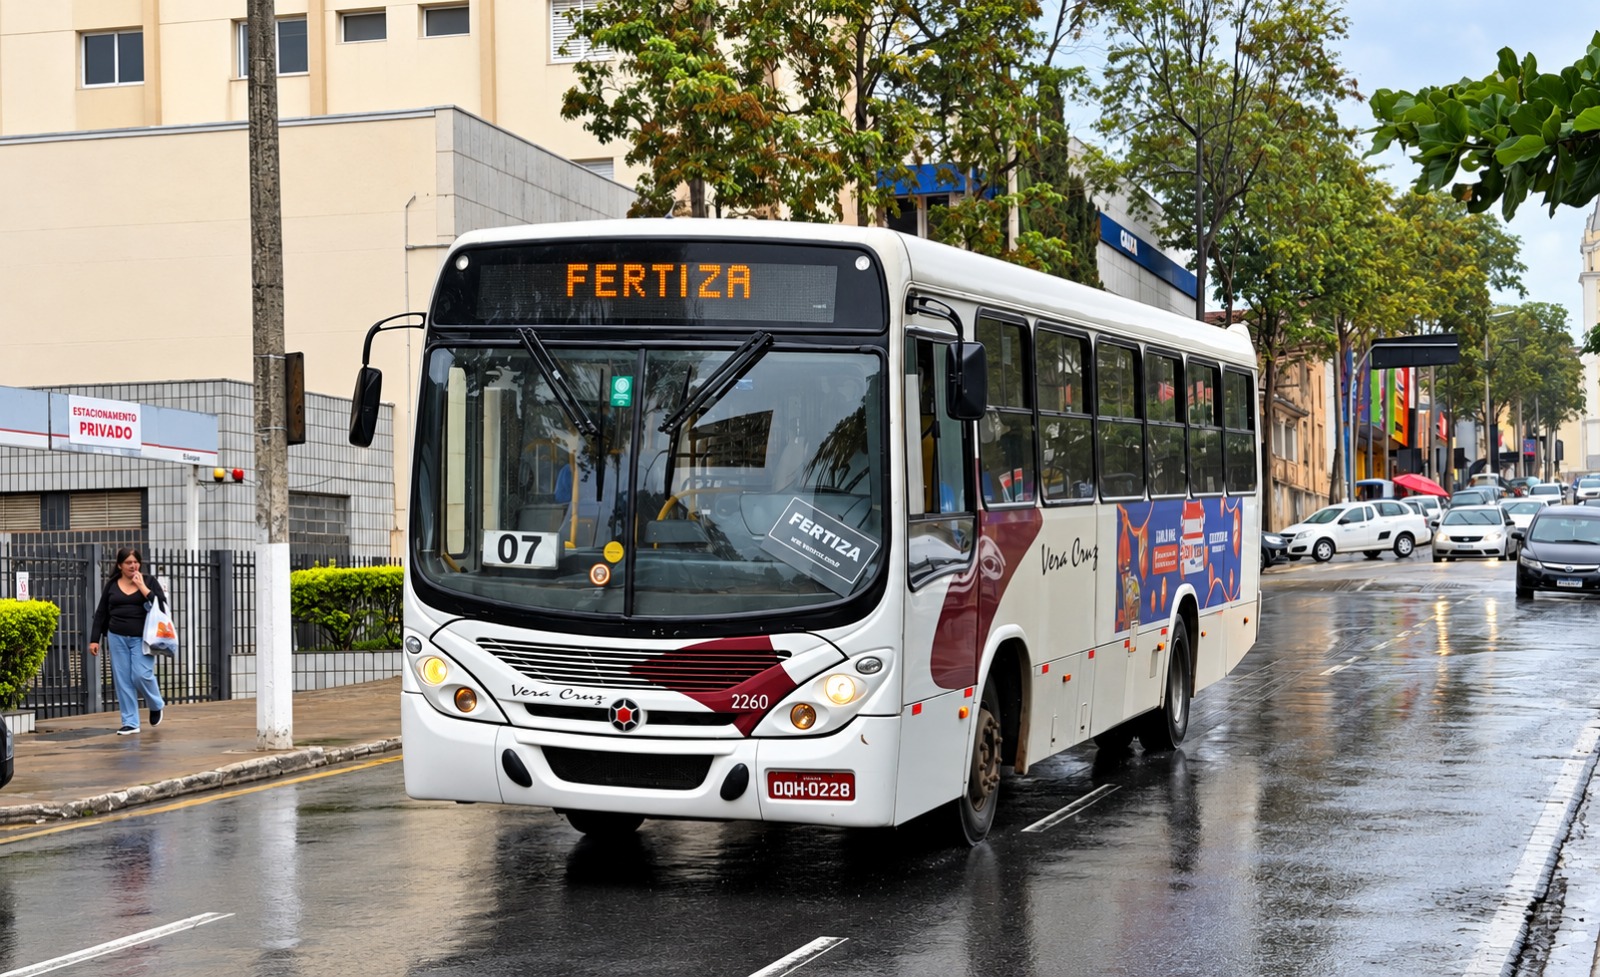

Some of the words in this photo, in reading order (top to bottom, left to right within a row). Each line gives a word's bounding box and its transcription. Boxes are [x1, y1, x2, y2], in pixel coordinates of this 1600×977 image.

[566, 263, 750, 298] FERTIZA
[73, 407, 137, 422] ESTACIONAMENTO
[80, 422, 132, 440] PRIVADO
[497, 533, 542, 564] 07
[788, 512, 861, 562] FERTIZA
[1041, 543, 1067, 576] Vera
[1071, 537, 1098, 571] Cruz
[511, 684, 551, 696] Vera
[559, 688, 607, 705] Cruz
[731, 694, 769, 709] 2260
